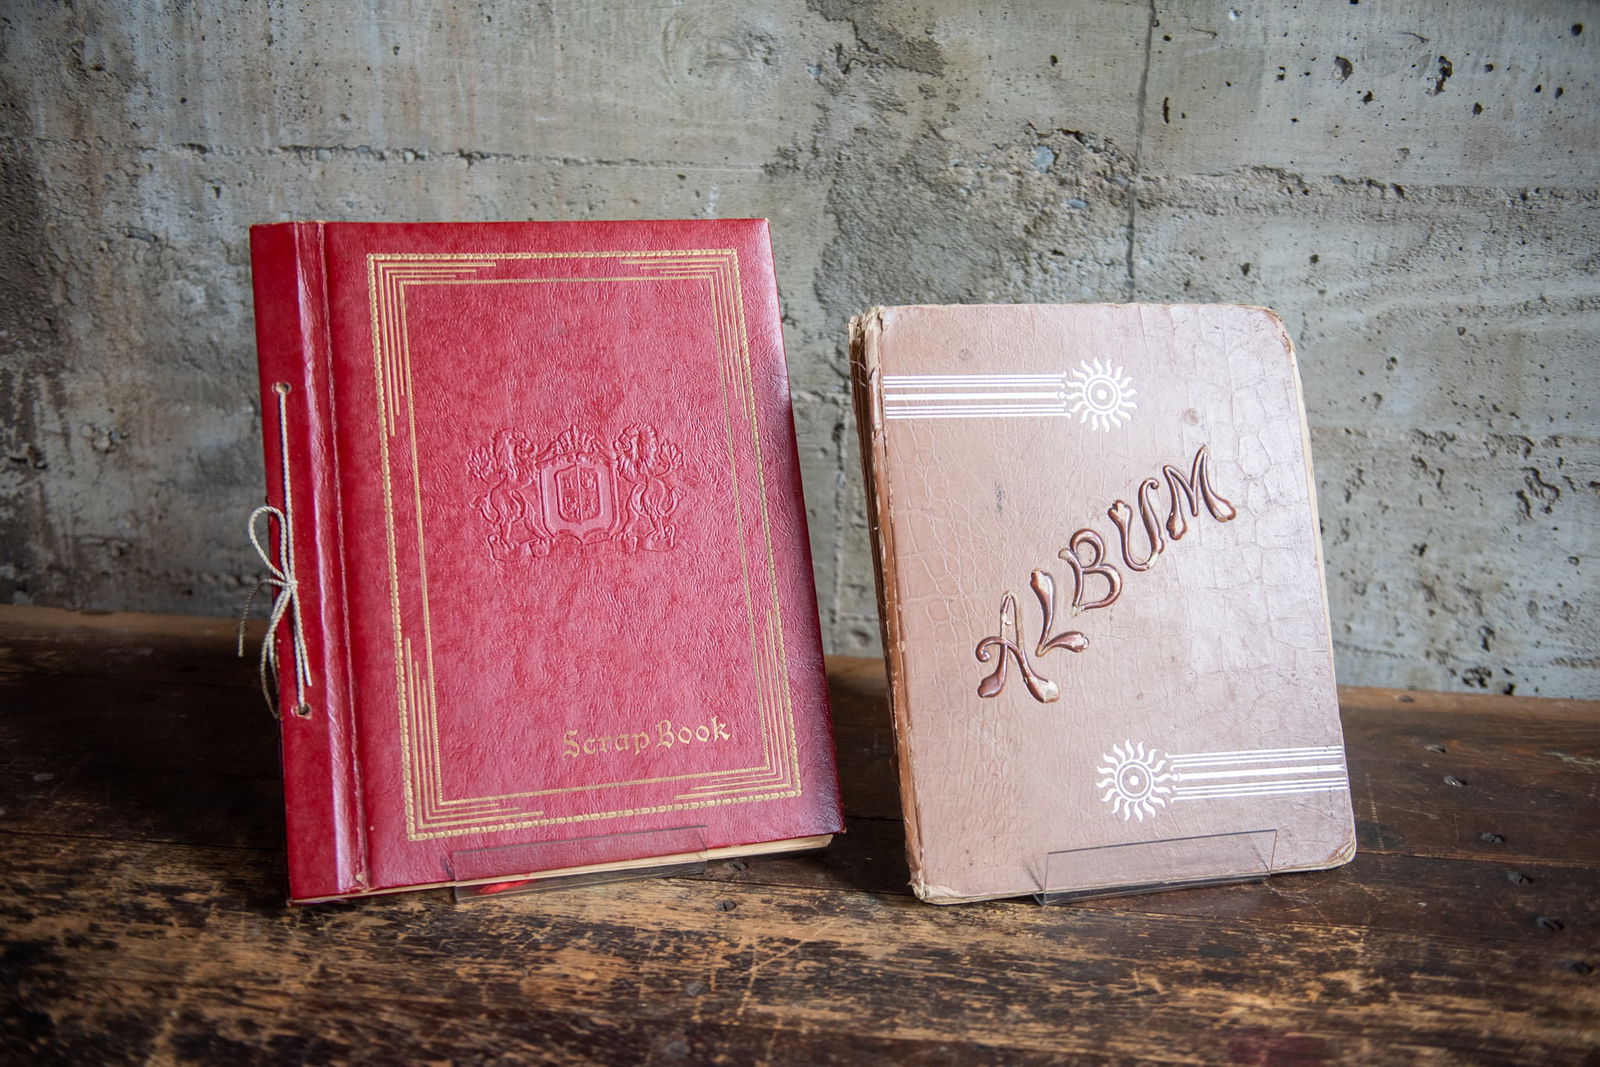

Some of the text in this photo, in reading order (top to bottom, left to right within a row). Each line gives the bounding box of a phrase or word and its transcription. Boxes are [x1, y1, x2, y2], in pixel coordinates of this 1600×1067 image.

[975, 445, 1237, 704] ALBUM
[563, 715, 732, 759] Scrap Book
